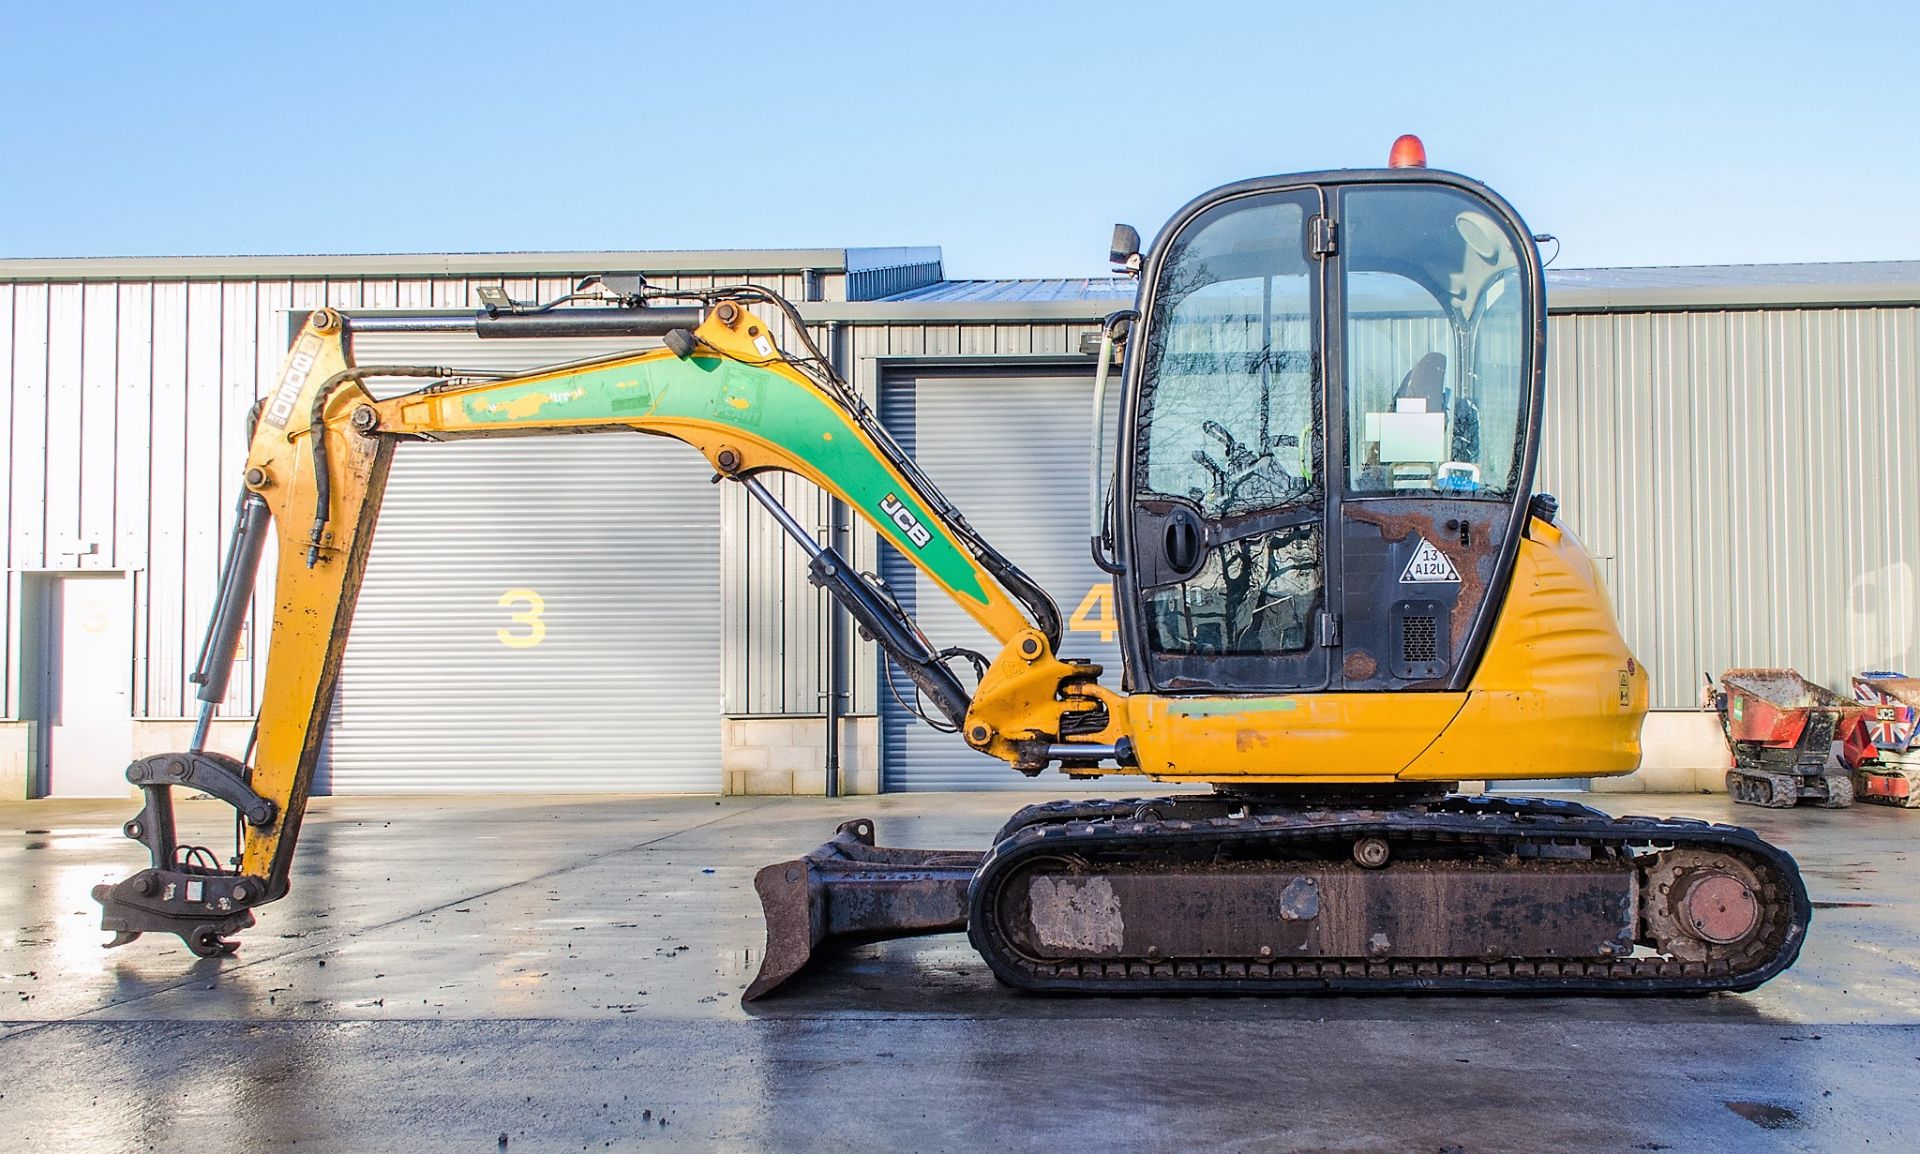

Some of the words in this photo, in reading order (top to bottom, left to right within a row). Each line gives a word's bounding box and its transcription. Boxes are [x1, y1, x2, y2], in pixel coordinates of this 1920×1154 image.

[880, 493, 931, 547] JCB
[1423, 550, 1438, 561] 13
[81, 602, 107, 633] 3
[496, 588, 546, 648] 3
[1069, 583, 1119, 642] 4
[1877, 708, 1895, 720] JCB
